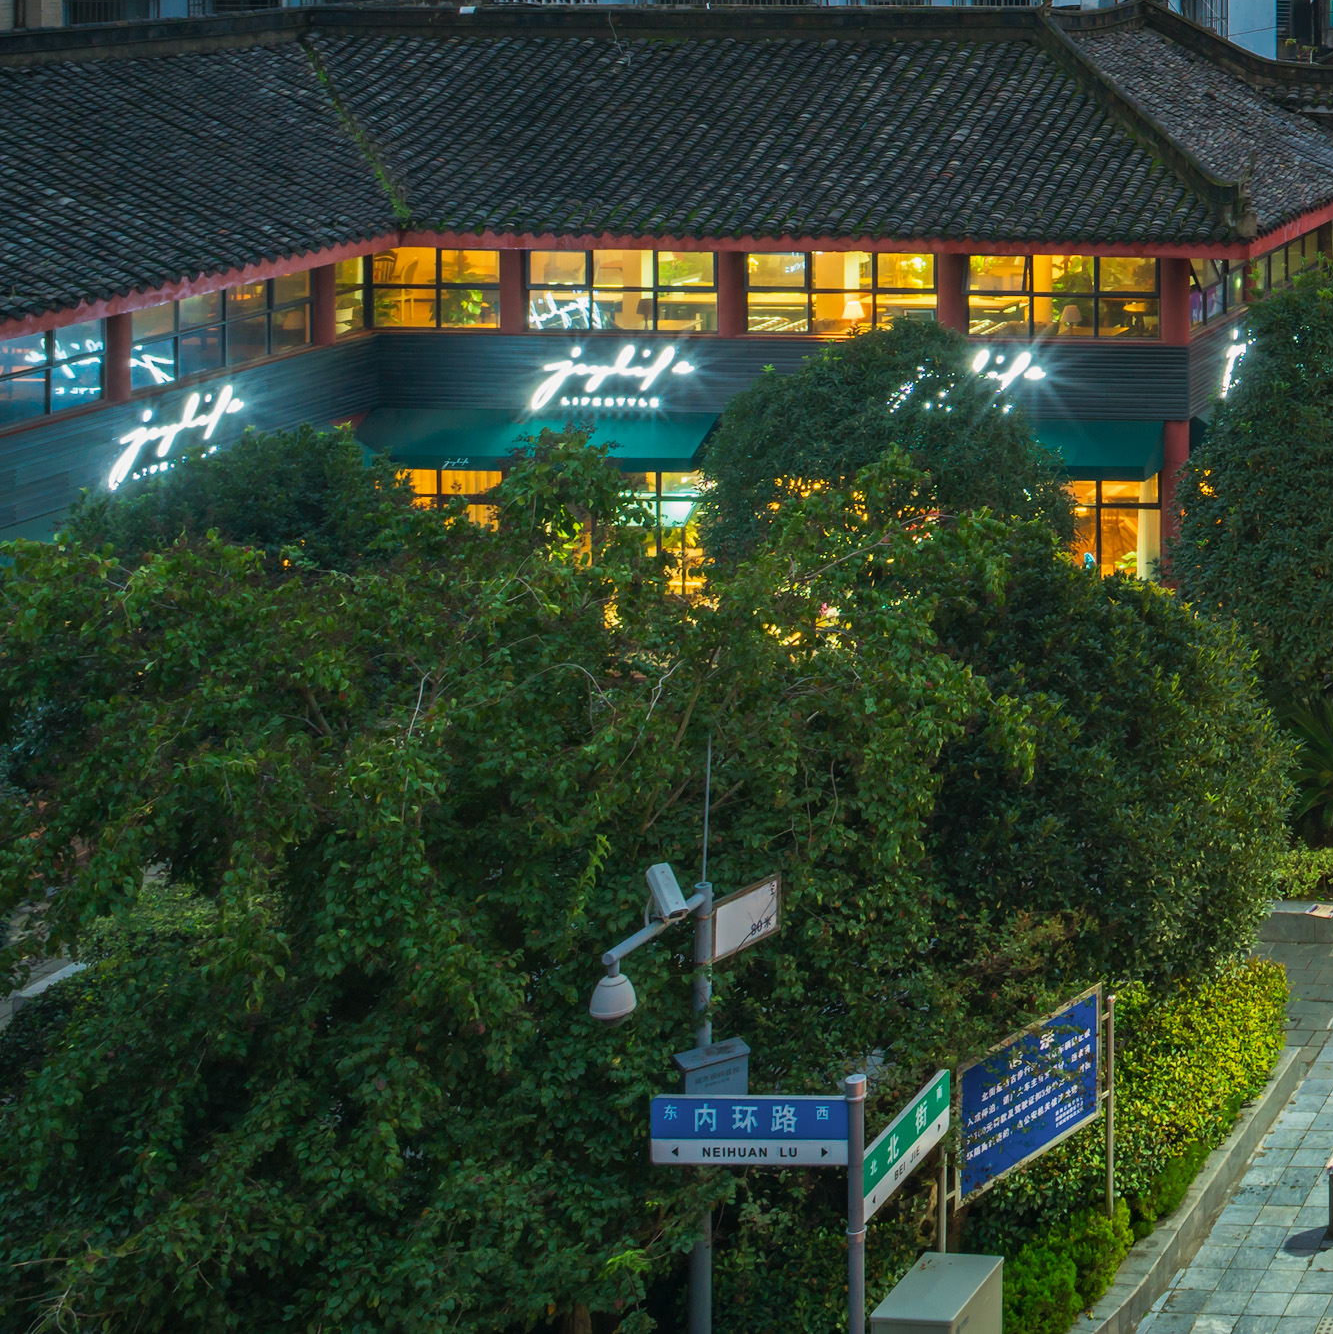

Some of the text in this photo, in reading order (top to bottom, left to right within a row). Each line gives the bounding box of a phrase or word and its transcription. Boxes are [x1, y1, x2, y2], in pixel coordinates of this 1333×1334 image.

[560, 396, 661, 409] LIFESTYLE
[663, 1103, 830, 1133] 东 内环路 西
[887, 1100, 927, 1165] 北街
[702, 1147, 798, 1158] NEIHUAN LU
[894, 1145, 920, 1181] BEI JIE
